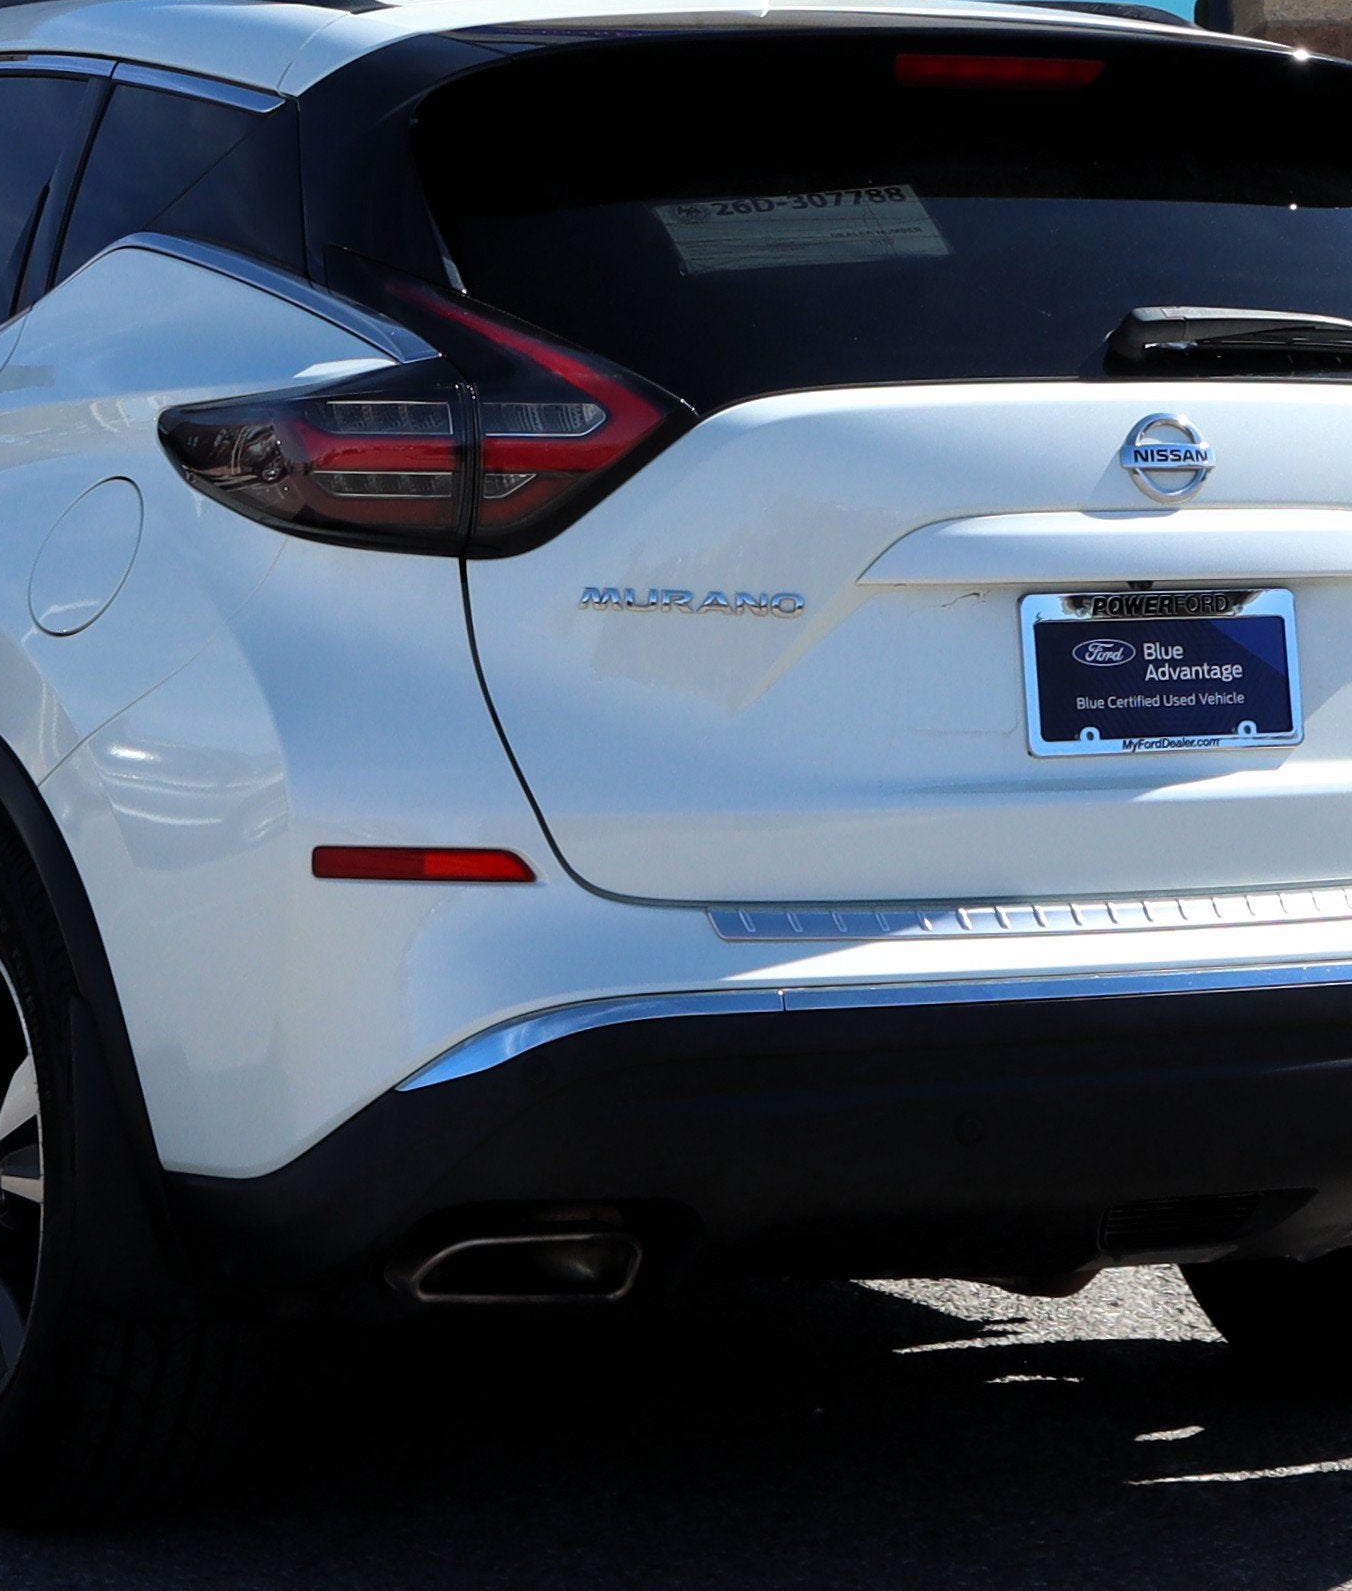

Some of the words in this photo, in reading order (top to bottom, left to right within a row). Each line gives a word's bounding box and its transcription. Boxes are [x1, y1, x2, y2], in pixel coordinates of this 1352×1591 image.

[712, 186, 907, 216] 26D-307788
[1133, 449, 1208, 463] NISSAN
[579, 586, 806, 619] MURANO
[1085, 642, 1124, 662] Ford
[1143, 642, 1184, 660] Blue
[1145, 662, 1244, 683] Advantage
[1076, 696, 1105, 710] Blue
[1107, 694, 1160, 709] Certified
[1162, 693, 1196, 707] Used
[1199, 691, 1245, 705] Vehicle
[1122, 737, 1222, 753] MyFordDealer.com
